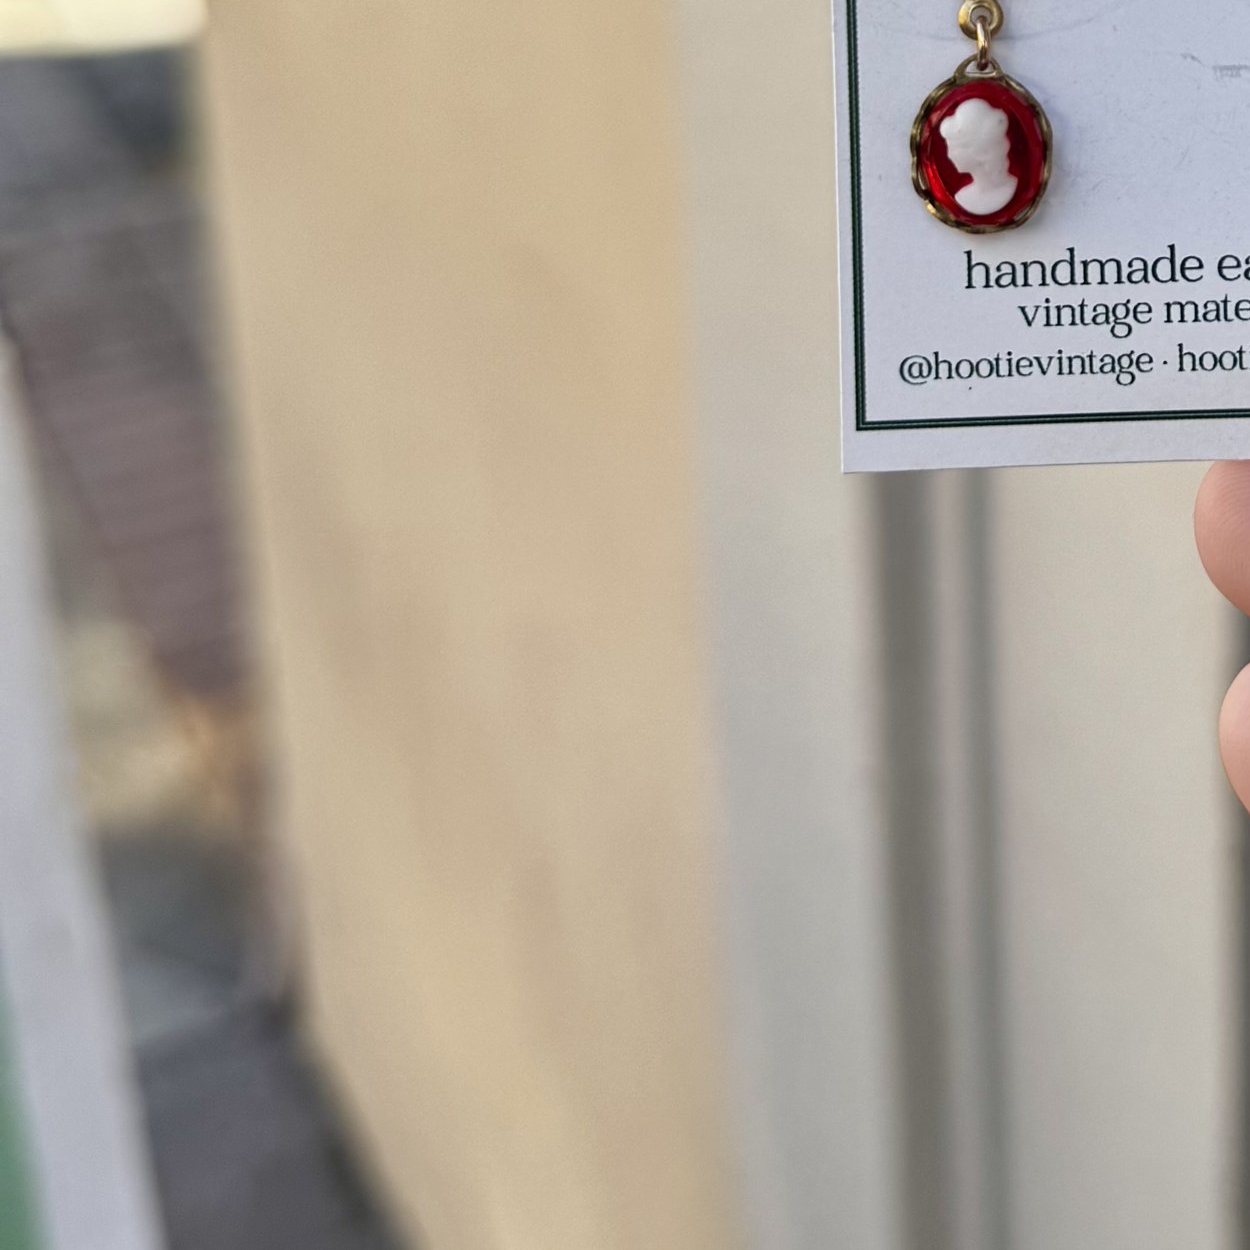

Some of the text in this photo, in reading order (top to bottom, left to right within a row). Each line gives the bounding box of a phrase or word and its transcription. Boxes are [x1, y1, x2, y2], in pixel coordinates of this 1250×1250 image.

[963, 244, 1205, 290] handmade
[1017, 297, 1153, 338] vintage
[898, 349, 1154, 387] @hootievintage
